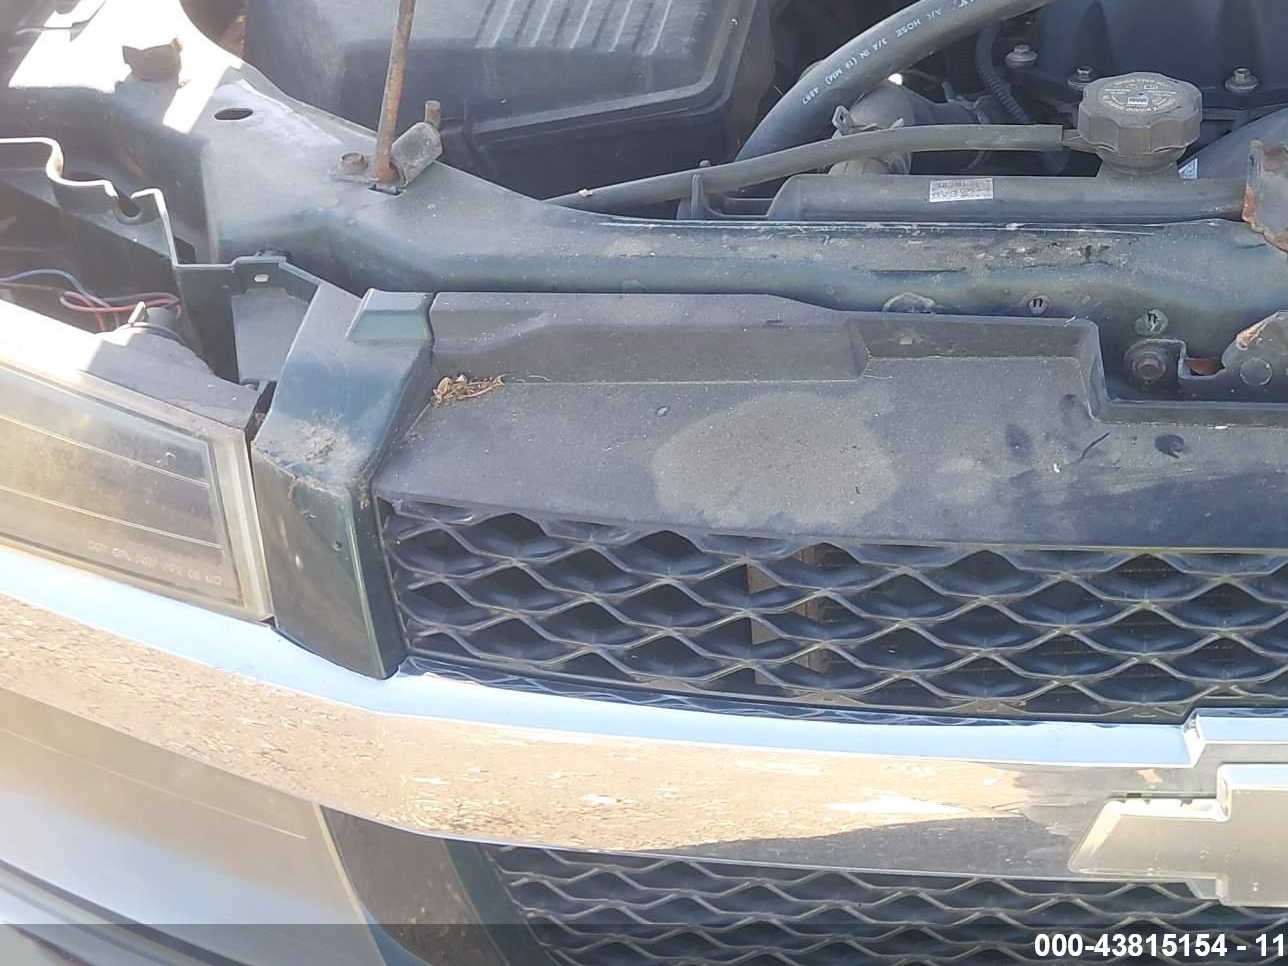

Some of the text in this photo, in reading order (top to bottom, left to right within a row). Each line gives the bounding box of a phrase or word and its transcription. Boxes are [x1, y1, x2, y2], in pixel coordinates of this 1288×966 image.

[896, 19, 921, 37] HOSE
[873, 38, 888, 50] 3/4
[859, 50, 870, 59] IN
